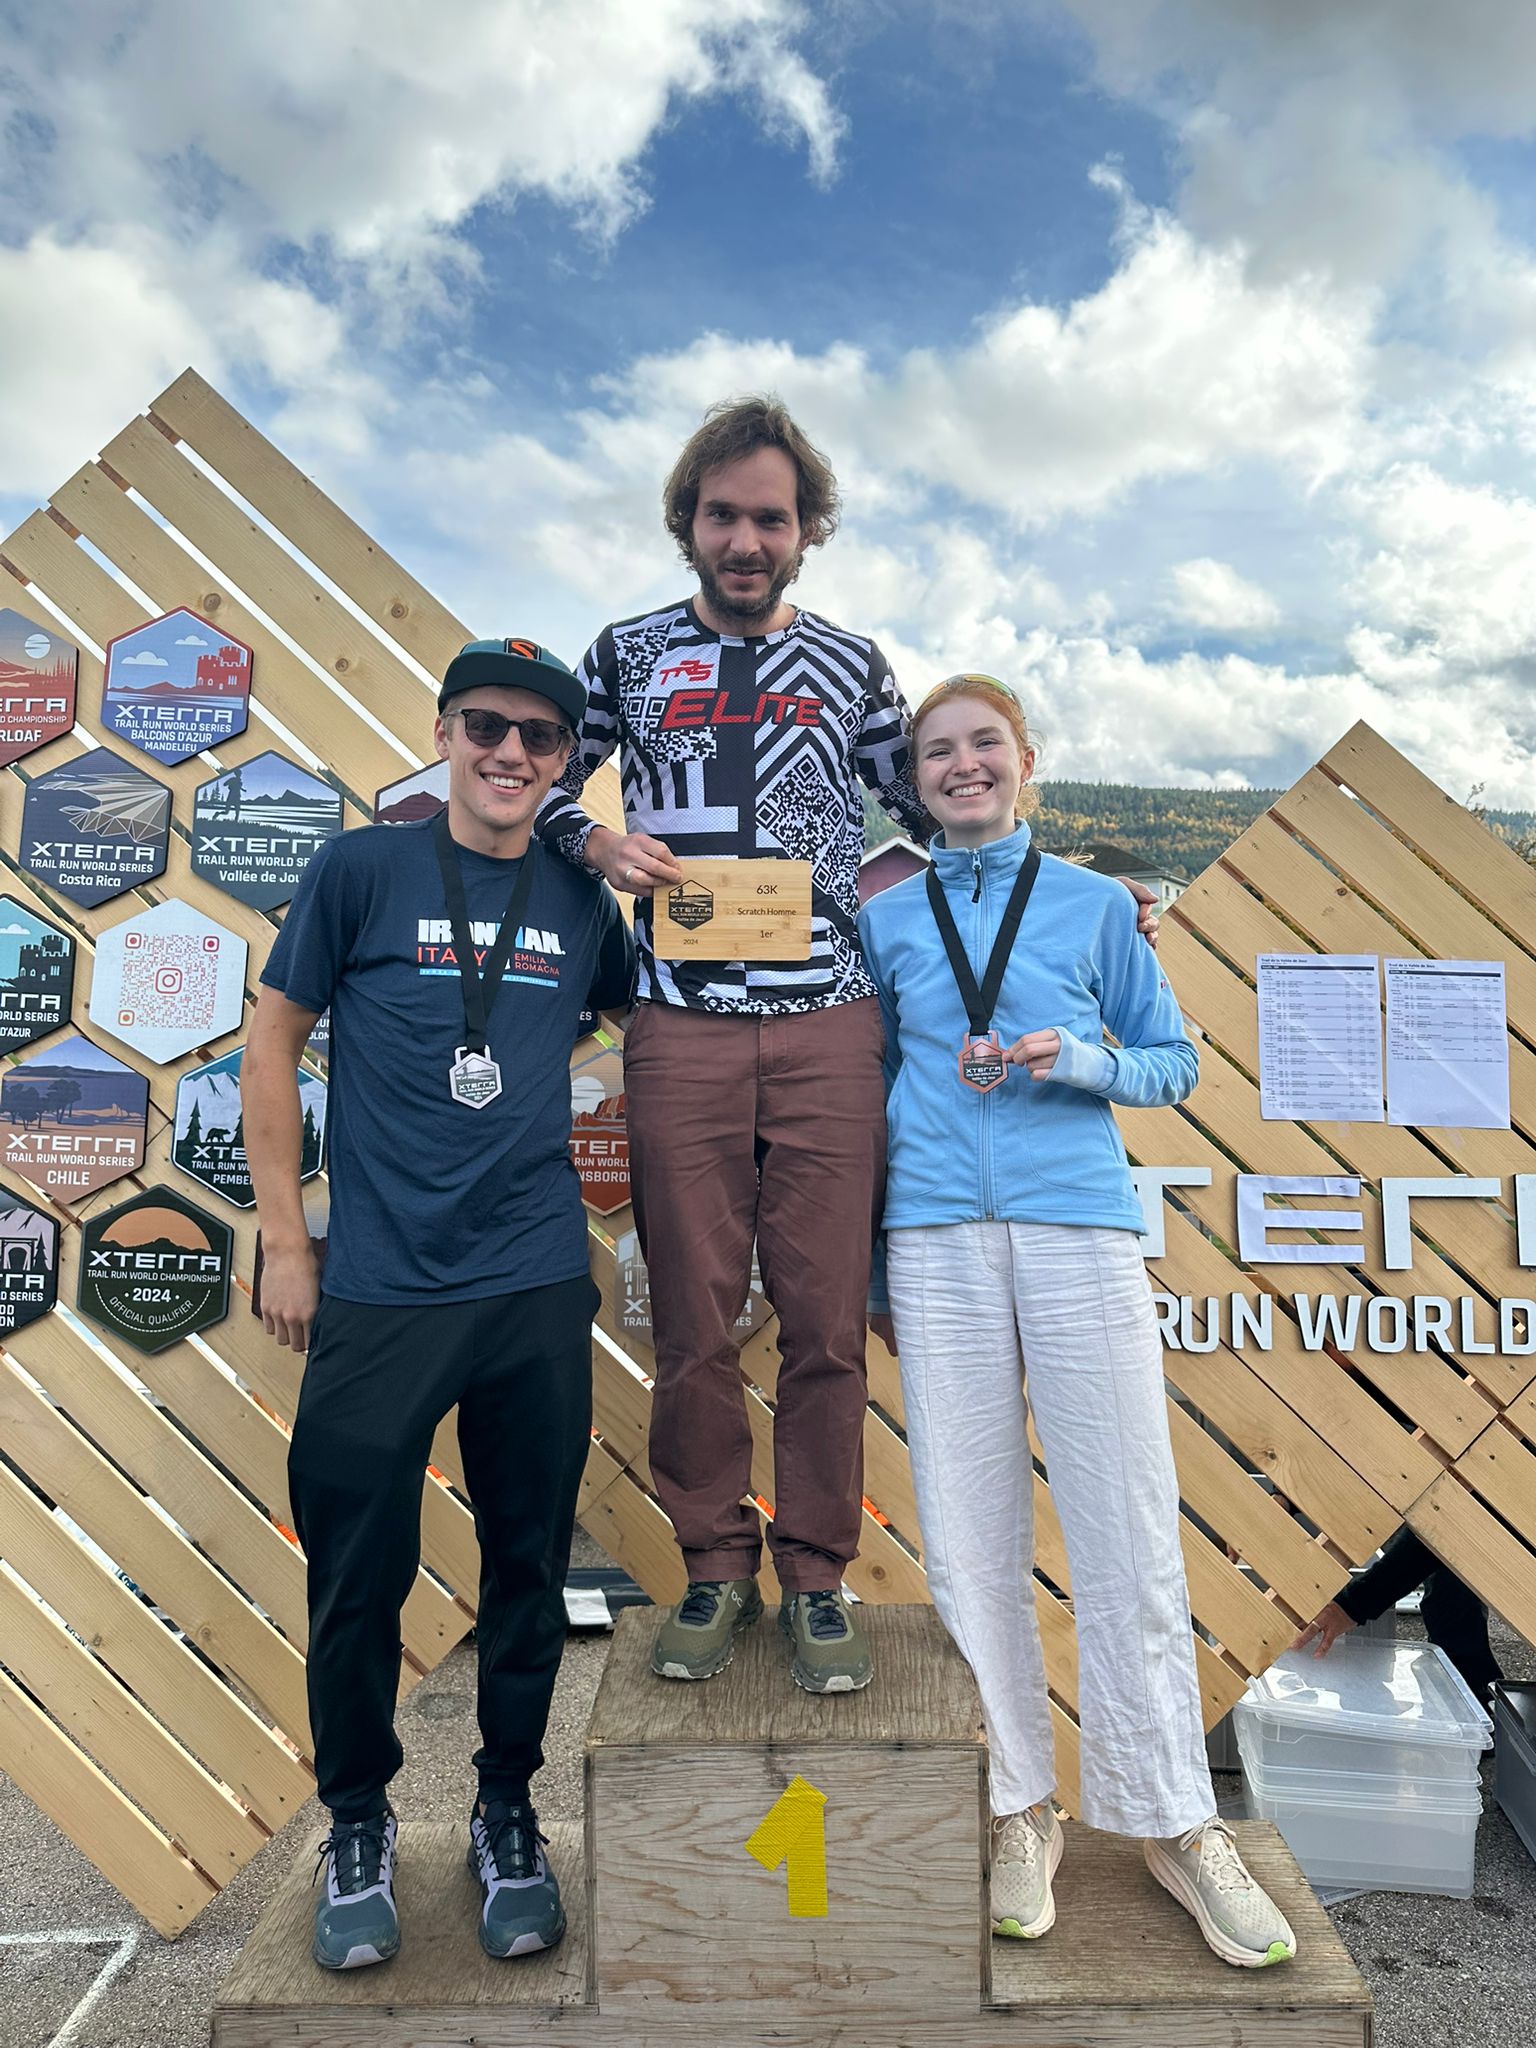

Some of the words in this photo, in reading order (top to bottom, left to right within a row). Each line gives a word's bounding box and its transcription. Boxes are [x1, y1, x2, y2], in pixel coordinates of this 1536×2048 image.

[659, 659, 714, 686] TRS
[0, 698, 67, 713] RRA
[660, 690, 823, 730] ELITE
[8, 715, 67, 723] CHAMPIONSHIP
[115, 704, 233, 723] XTERRA
[115, 719, 140, 729] TRAIL
[142, 721, 162, 730] RUN
[164, 722, 197, 731] WORLD
[199, 723, 232, 733] SERIES
[131, 729, 176, 741] BALCONS
[178, 731, 213, 743] D'AZUR
[144, 741, 197, 752] MANDELIEU
[31, 841, 155, 861] XTERRA
[30, 858, 57, 869] TRAIL
[59, 860, 80, 870] RUN
[82, 861, 117, 872] WORLD
[119, 863, 154, 873] SERIES
[197, 855, 228, 865] TRAIL
[230, 855, 253, 866] RUN
[255, 856, 294, 867] WORLD
[58, 873, 93, 886] Costa
[96, 875, 122, 887] Rica
[219, 870, 258, 882] Vallée
[261, 871, 277, 883] de
[756, 885, 778, 895] 63K
[737, 908, 767, 916] Scratch
[767, 908, 797, 916] Homme
[760, 930, 774, 939] 1er
[417, 946, 487, 967] ITAY
[514, 953, 547, 965] EMILIA
[514, 962, 560, 976] ROMAGNA
[24, 1011, 60, 1023] SERIES
[0, 1027, 31, 1038] D'AZUR
[6, 1133, 136, 1154] XTERRA
[6, 1152, 34, 1163] TRAIL
[36, 1153, 58, 1164] RUN
[60, 1154, 96, 1165] WORLD
[98, 1155, 135, 1167] SERIES
[191, 1160, 216, 1170] TRAIL
[217, 1162, 236, 1171] RUN
[574, 1158, 595, 1166] RUN
[47, 1170, 91, 1185] CHILE
[89, 1250, 221, 1271] XTERRA
[87, 1269, 109, 1279] TRAIL
[111, 1270, 128, 1279] RUN
[130, 1271, 158, 1281] WORLD
[160, 1272, 221, 1283] CHAMPIONSHIP
[10, 1291, 44, 1302] SERIES
[132, 1287, 172, 1303] 2024
[109, 1296, 145, 1324] OFFICIAL
[148, 1299, 194, 1326] QUALIFIER
[623, 1317, 652, 1327] TRAIL
[1153, 1291, 1273, 1353] RUN
[1293, 1293, 1536, 1355] WORLD
[744, 1773, 828, 1917] 1
